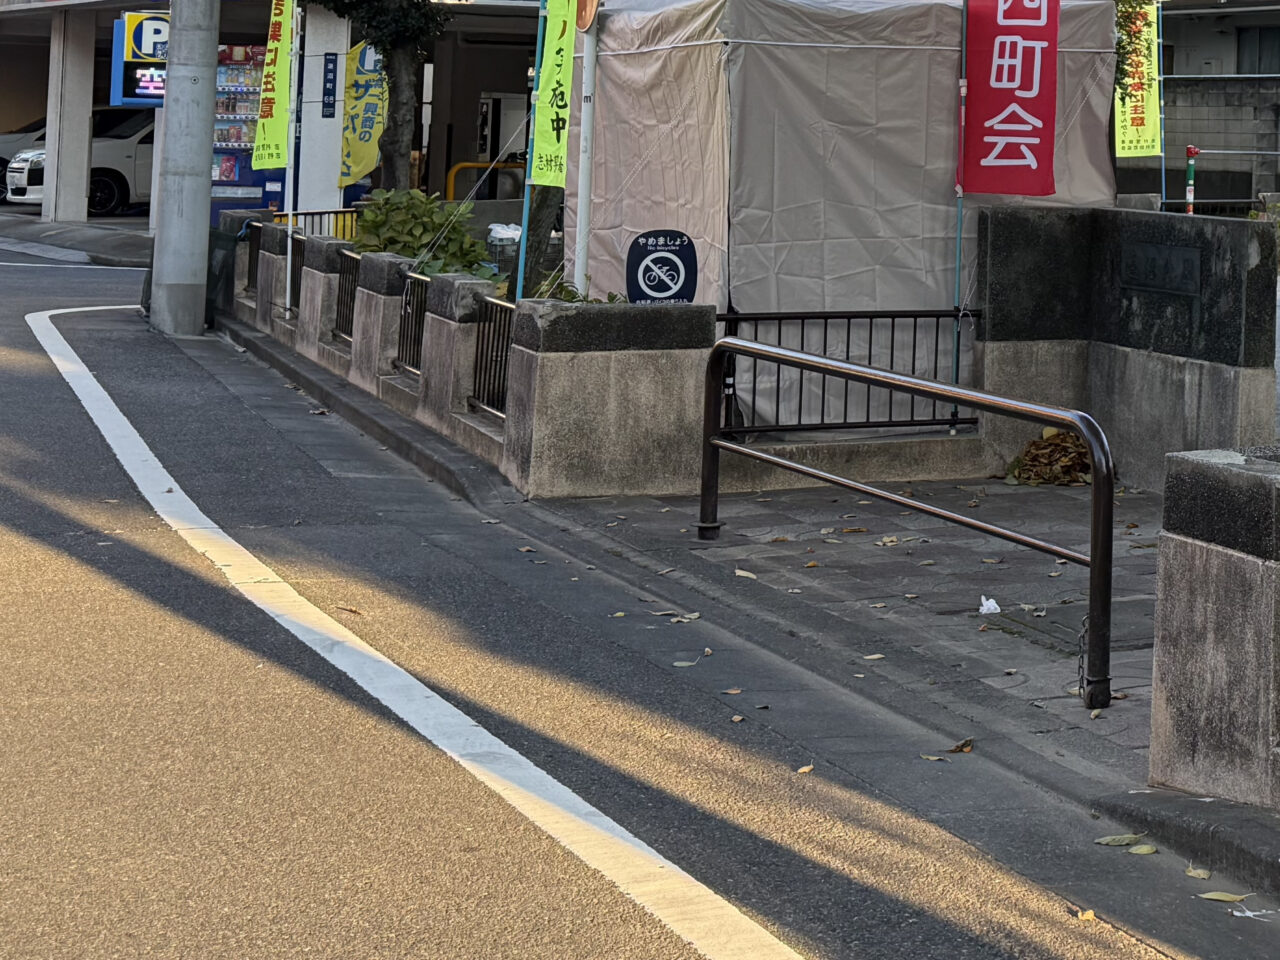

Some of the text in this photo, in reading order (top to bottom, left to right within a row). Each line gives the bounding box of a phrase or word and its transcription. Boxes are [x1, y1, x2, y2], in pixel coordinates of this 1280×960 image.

[142, 20, 170, 54] P
[136, 67, 167, 94] 空
[638, 236, 689, 246] やめましょう
